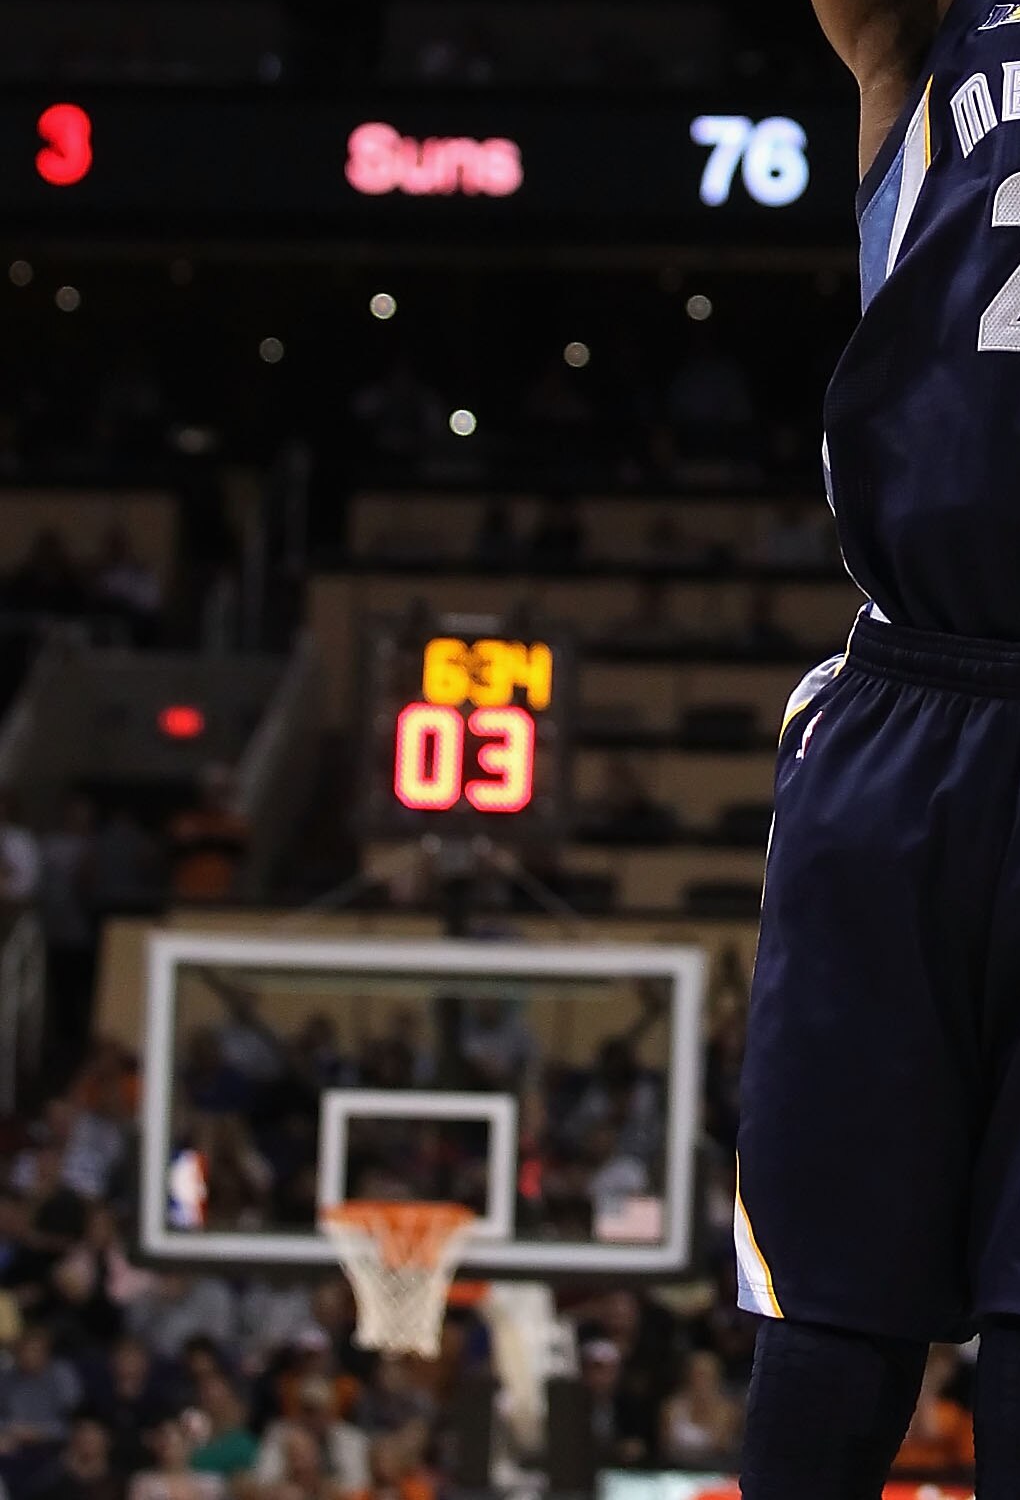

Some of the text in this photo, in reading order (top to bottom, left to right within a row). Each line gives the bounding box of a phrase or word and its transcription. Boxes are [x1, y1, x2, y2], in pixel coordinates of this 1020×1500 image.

[36, 104, 92, 186] 3
[345, 122, 523, 197] Suns
[690, 115, 810, 207] 76
[395, 702, 536, 812] 03
